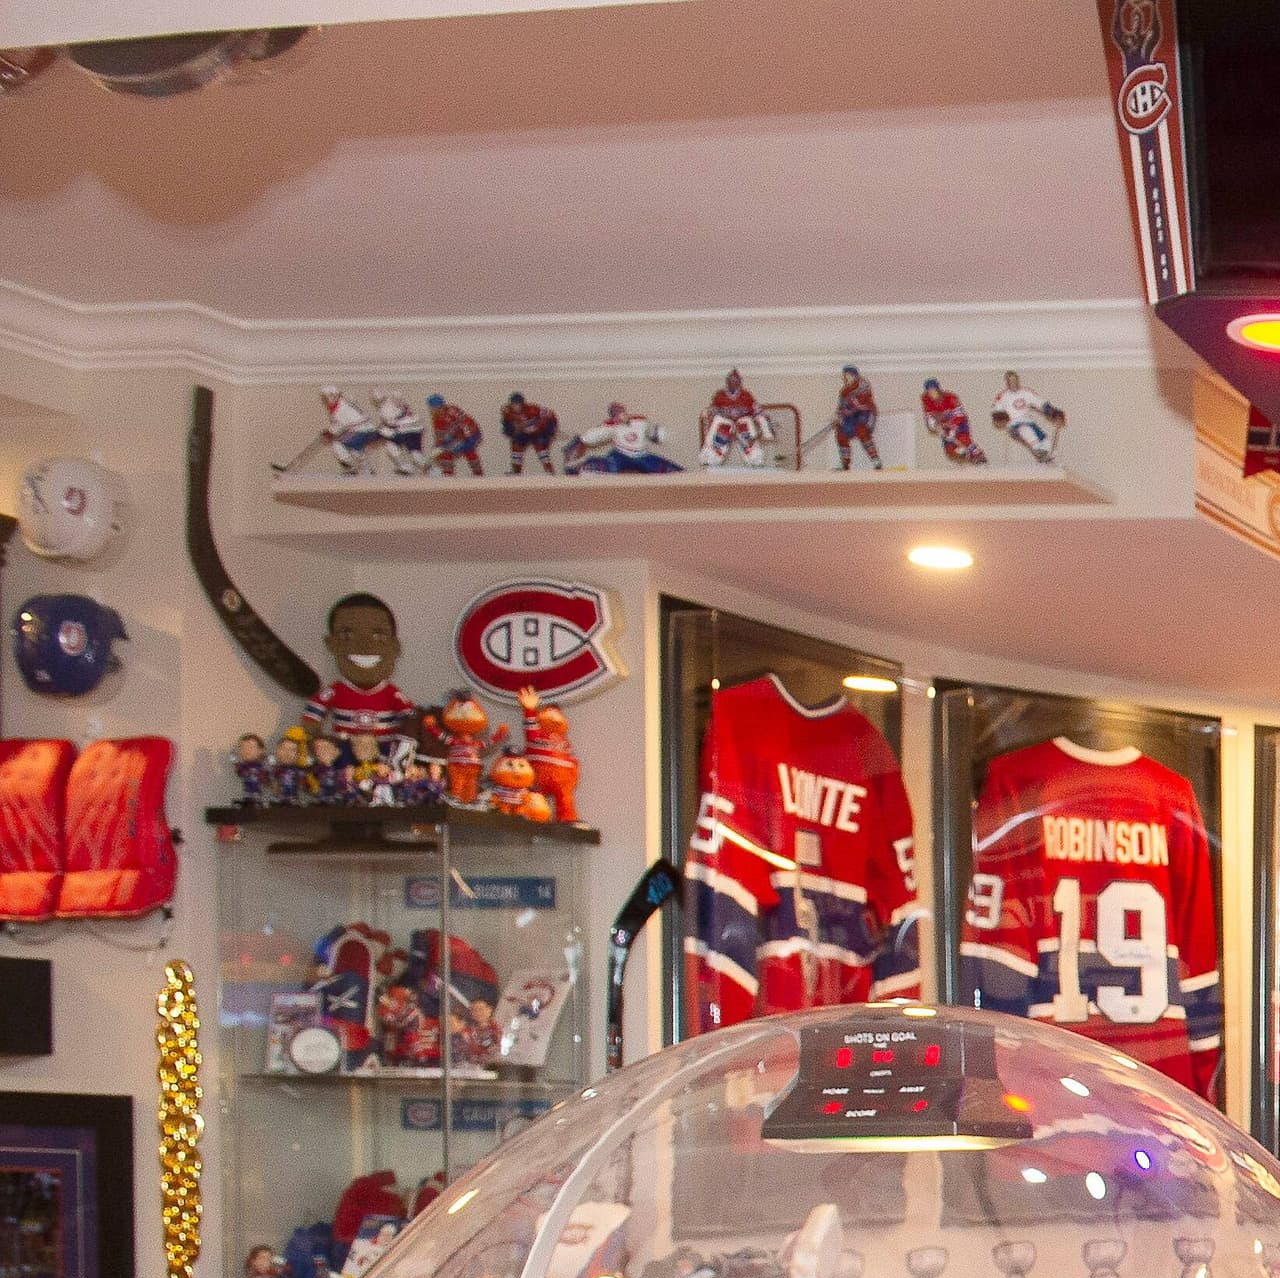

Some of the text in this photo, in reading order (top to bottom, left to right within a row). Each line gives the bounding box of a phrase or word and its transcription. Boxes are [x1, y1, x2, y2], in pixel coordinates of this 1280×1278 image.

[1044, 812, 1169, 867] ROBINSON
[1051, 877, 1169, 1024] 19
[891, 1031, 917, 1042] GOAL
